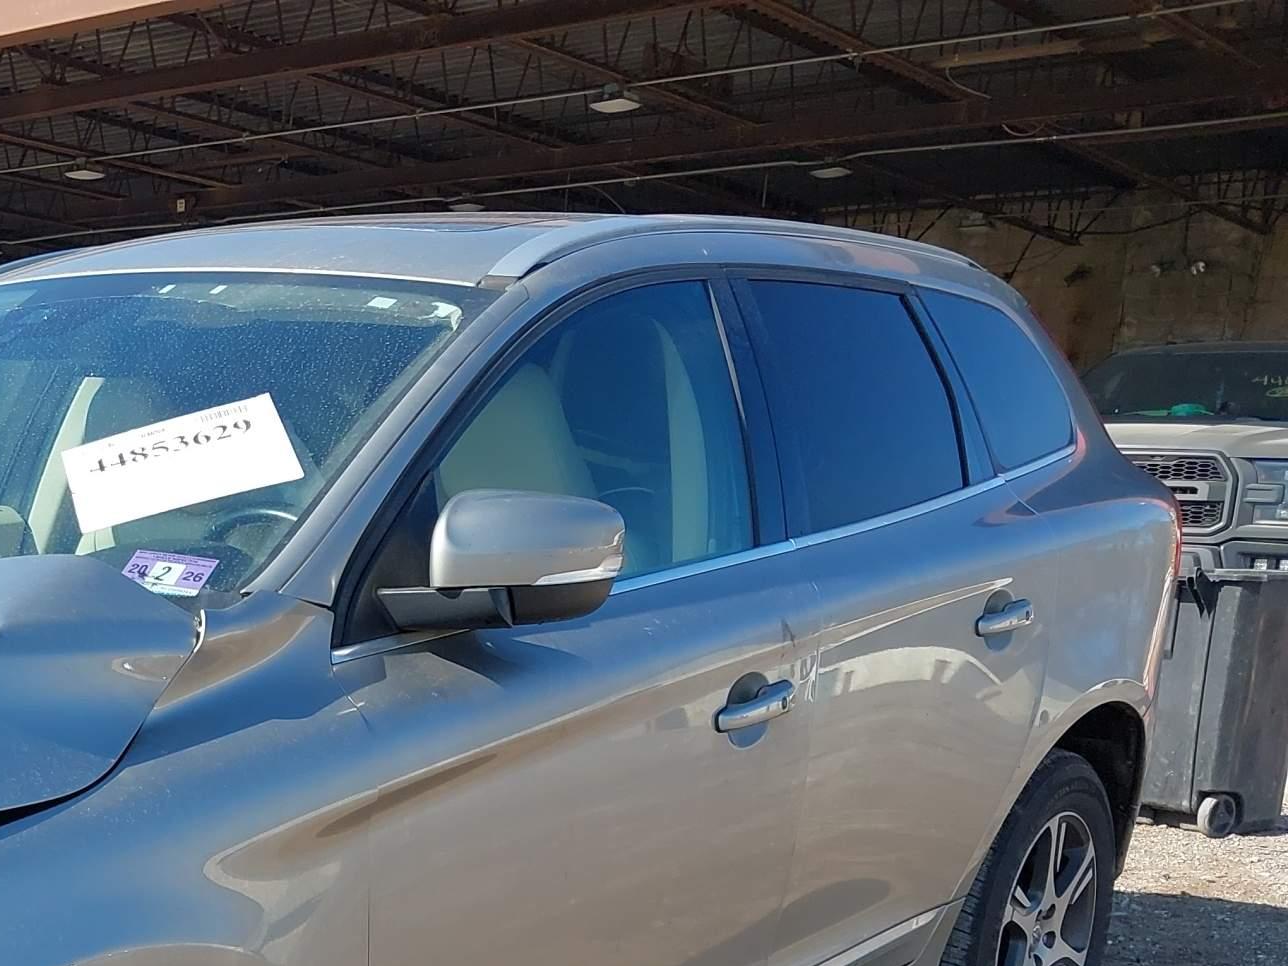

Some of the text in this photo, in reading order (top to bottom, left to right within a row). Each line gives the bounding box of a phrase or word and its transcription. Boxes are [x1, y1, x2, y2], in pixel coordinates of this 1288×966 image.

[89, 418, 252, 473] 44853629
[154, 566, 172, 581] 2
[182, 571, 205, 582] 26
